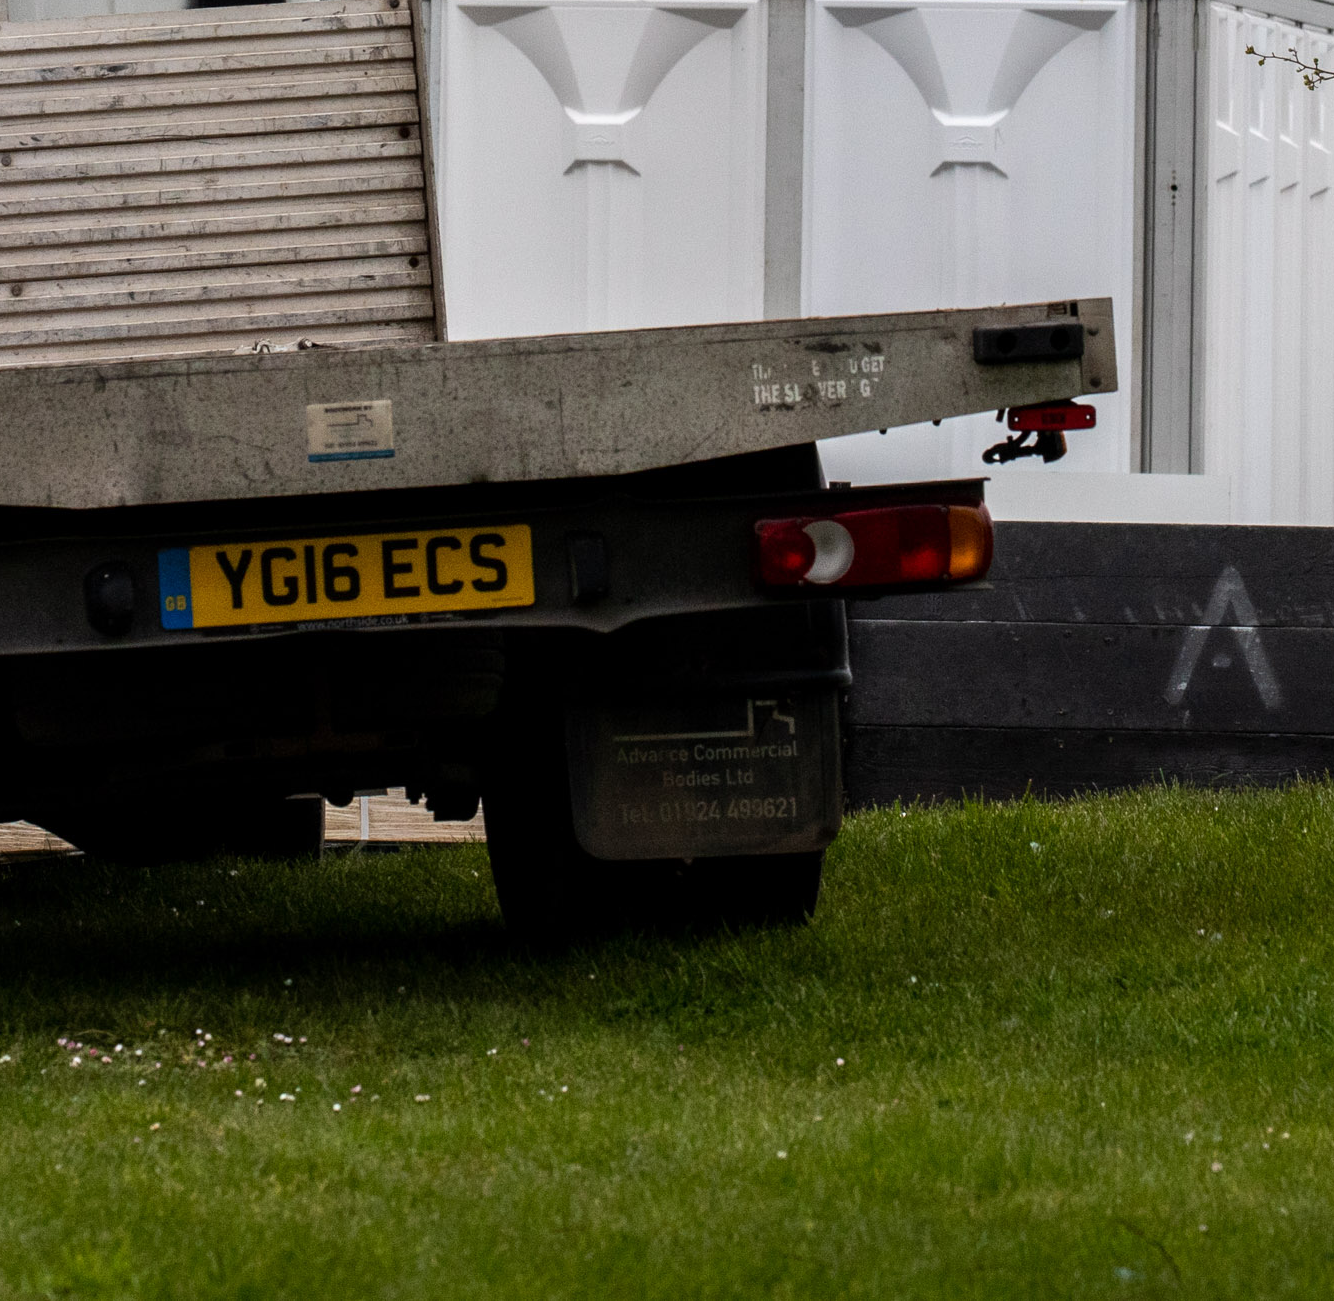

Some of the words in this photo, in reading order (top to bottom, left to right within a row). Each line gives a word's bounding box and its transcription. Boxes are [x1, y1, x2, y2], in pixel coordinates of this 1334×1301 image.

[860, 355, 886, 373] GET
[753, 384, 781, 404] THE
[214, 543, 361, 610] YG16
[382, 533, 509, 599] ECS
[165, 594, 187, 612] GB
[616, 746, 689, 765] Advance
[693, 741, 798, 762] Commercial
[662, 771, 721, 787] Bodies
[725, 769, 755, 786] Ltd
[659, 800, 721, 824] 01924
[726, 797, 798, 820] 499621
